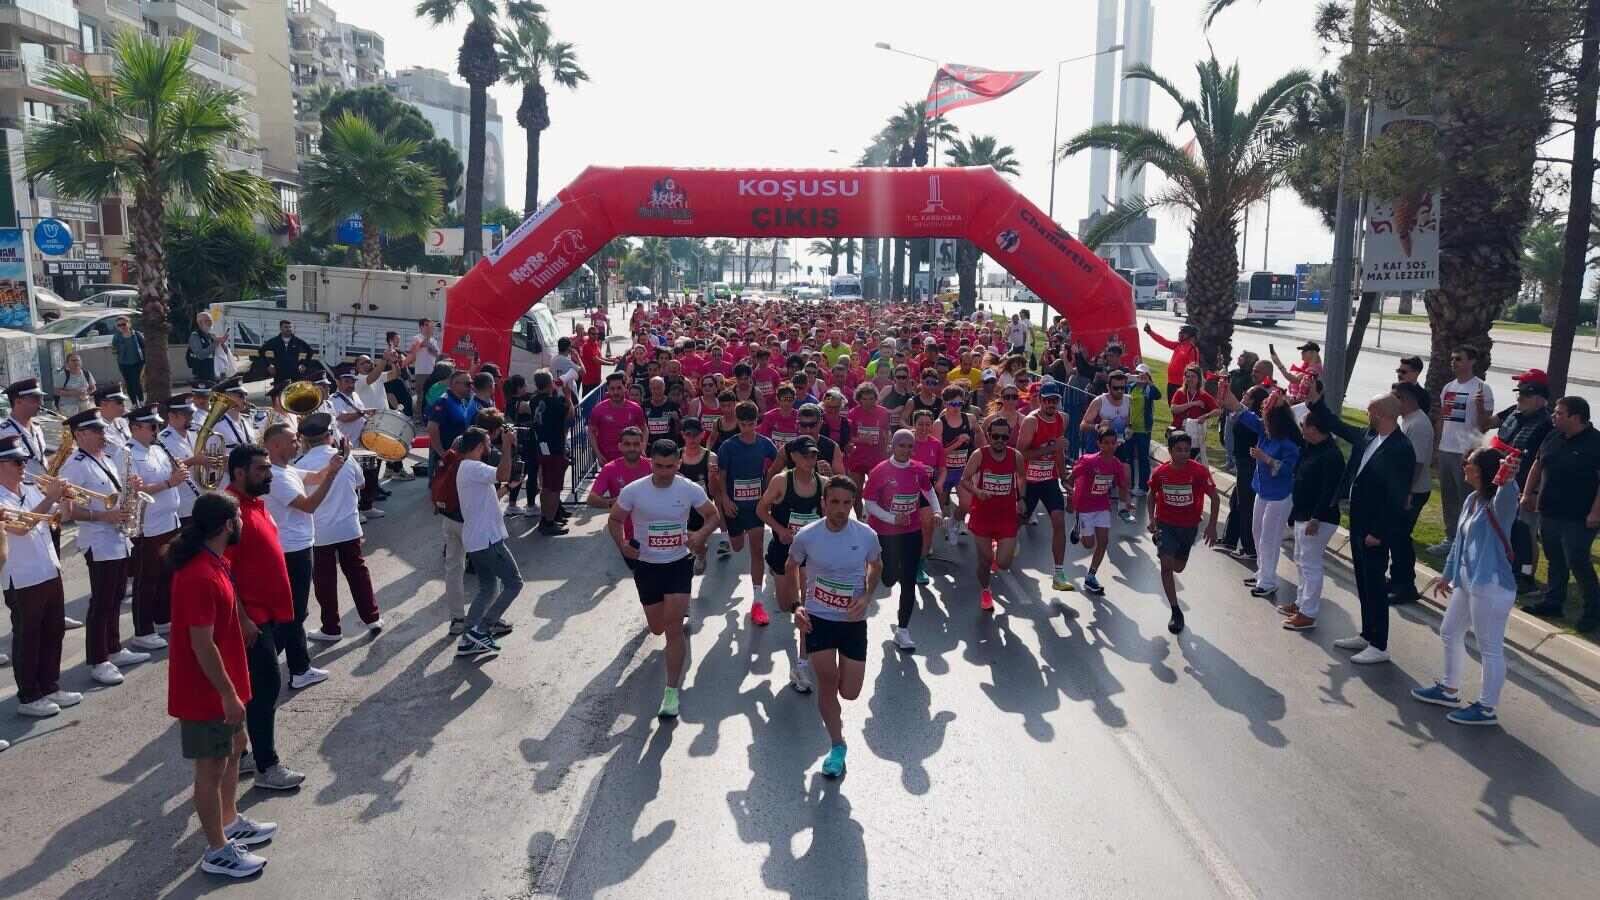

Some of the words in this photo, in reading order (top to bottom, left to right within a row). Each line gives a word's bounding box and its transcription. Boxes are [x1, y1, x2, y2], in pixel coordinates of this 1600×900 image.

[739, 179, 859, 201] KOŞUSU
[751, 207, 840, 229] ÇIKIŞ
[1383, 262, 1402, 270] KAT
[1407, 261, 1426, 269] SOS
[1367, 272, 1391, 280] MAX
[650, 536, 681, 546] 35227
[815, 590, 849, 607] 35143
